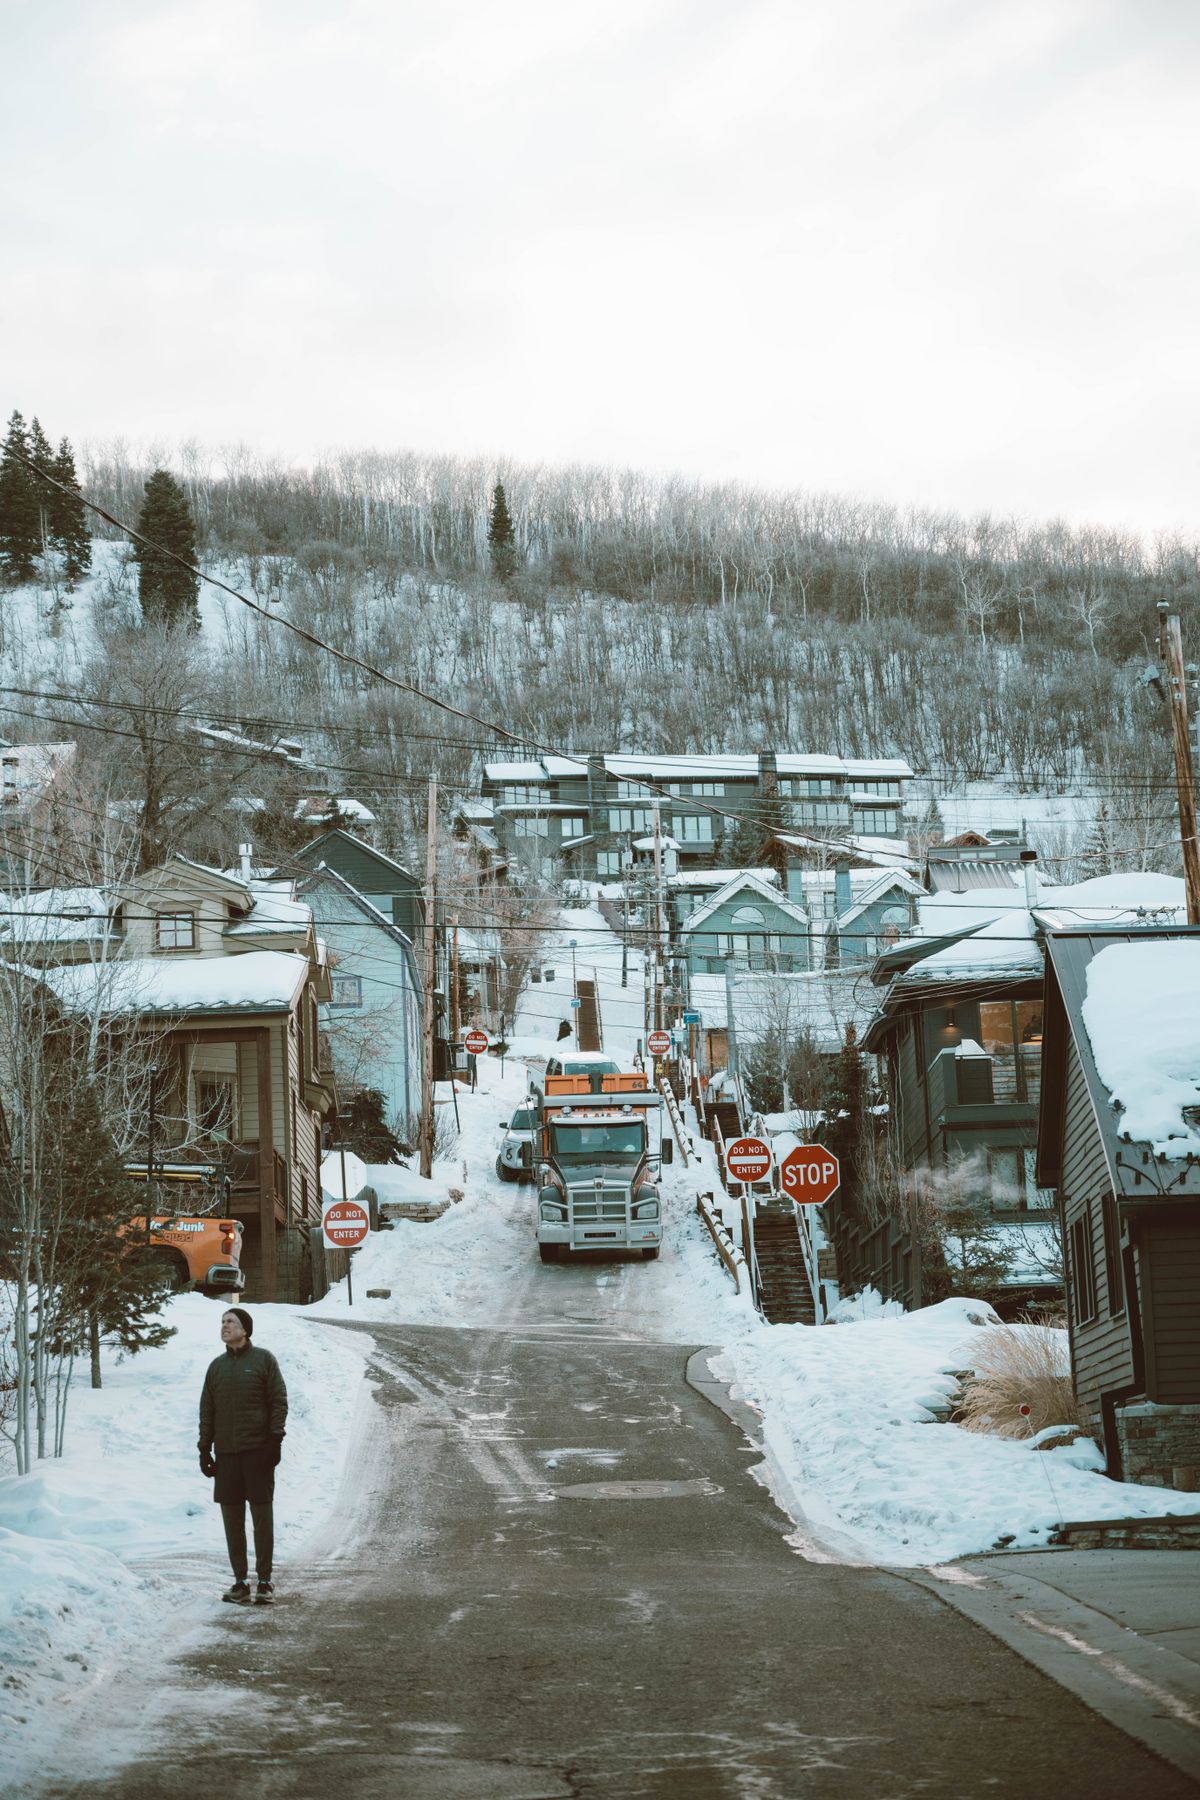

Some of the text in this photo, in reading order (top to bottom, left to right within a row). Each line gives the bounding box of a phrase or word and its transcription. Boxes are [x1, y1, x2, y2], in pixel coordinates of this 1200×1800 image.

[733, 1146, 764, 1154] DO NOT
[737, 1166, 762, 1174] ENTER
[785, 1162, 835, 1187] STOP
[330, 1210, 362, 1219] DO NOT
[176, 1221, 205, 1232] Junk
[333, 1230, 360, 1239] ENTER
